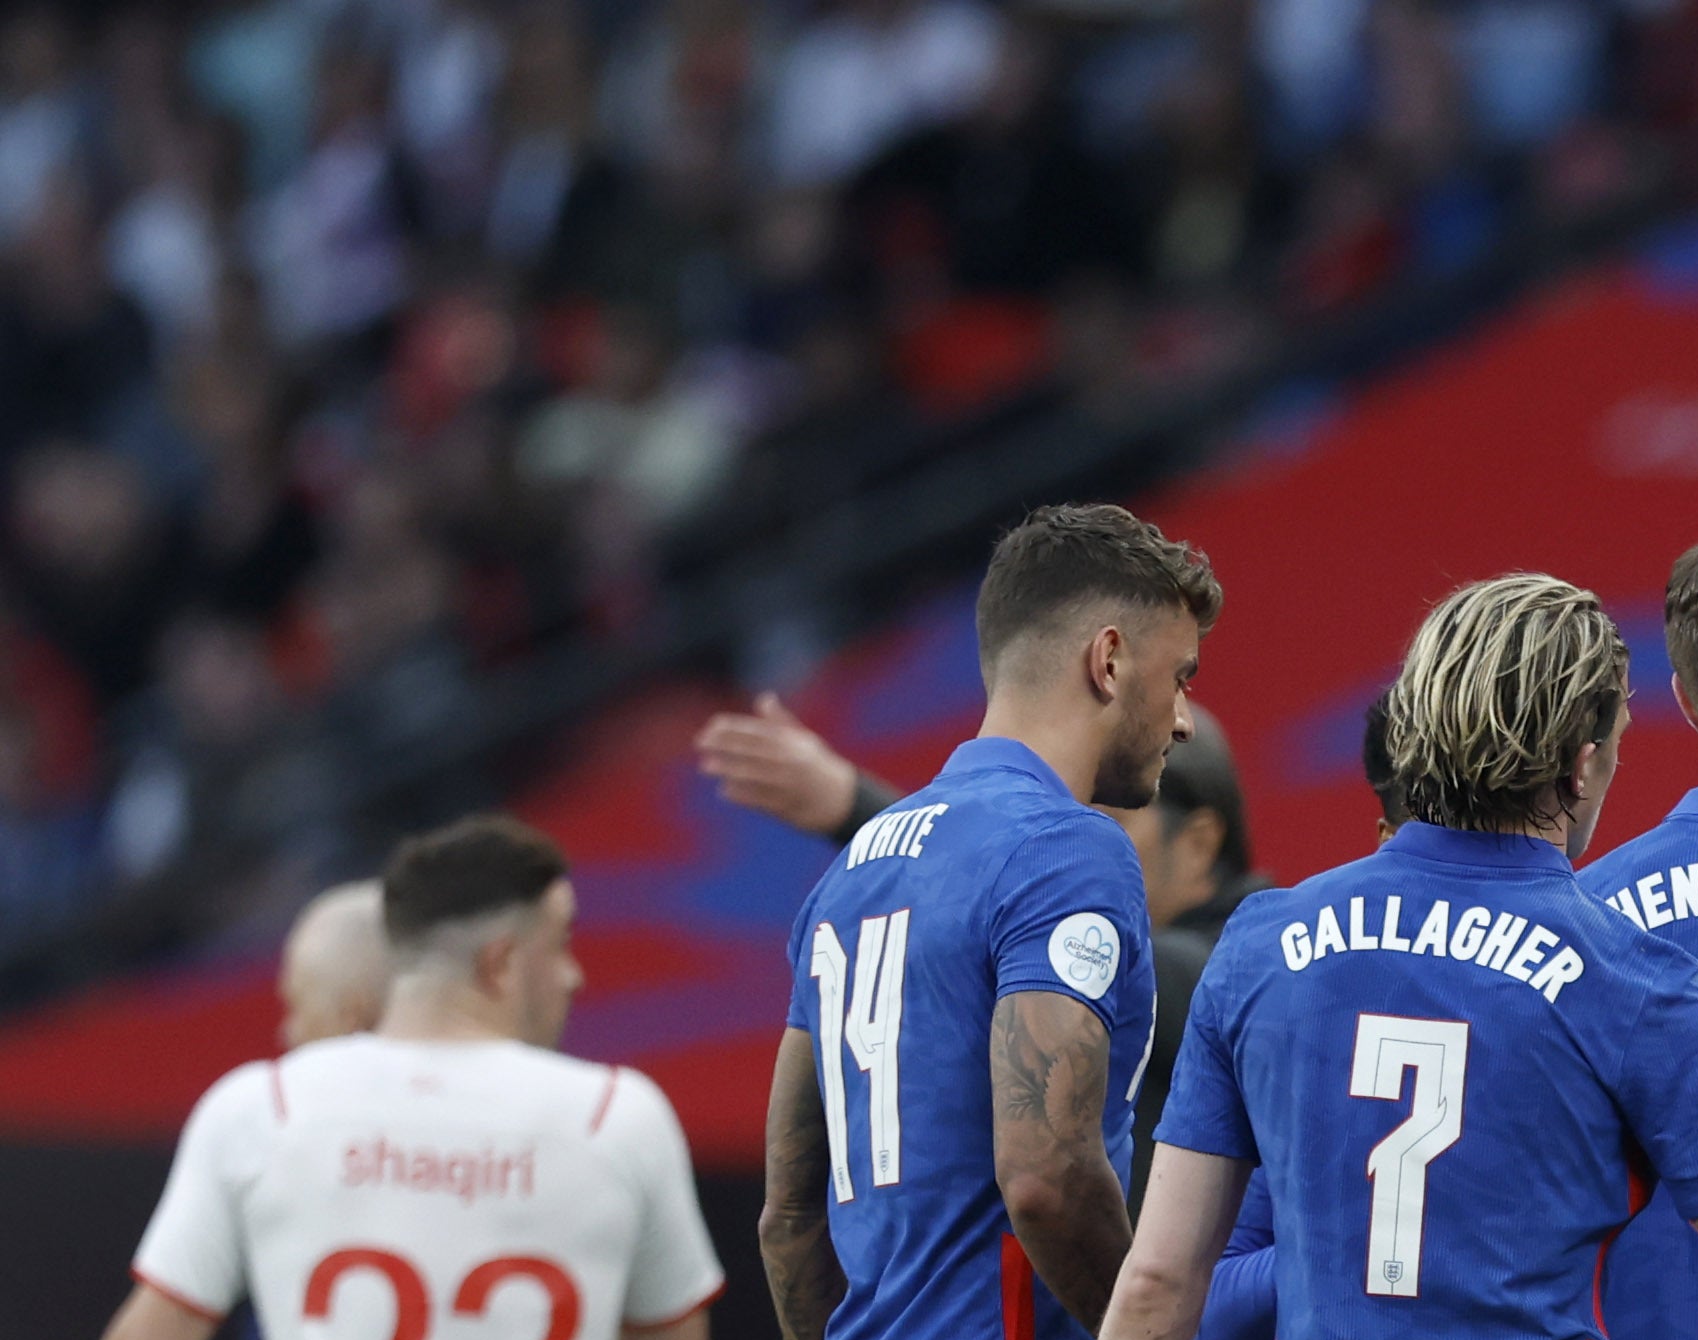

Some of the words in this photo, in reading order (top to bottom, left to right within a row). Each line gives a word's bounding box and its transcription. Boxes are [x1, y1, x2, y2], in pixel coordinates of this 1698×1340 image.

[846, 803, 950, 871] WHITE
[1280, 895, 1585, 1004] GALLAGHER
[810, 908, 910, 1204] 14
[1349, 1012, 1470, 1298] 7
